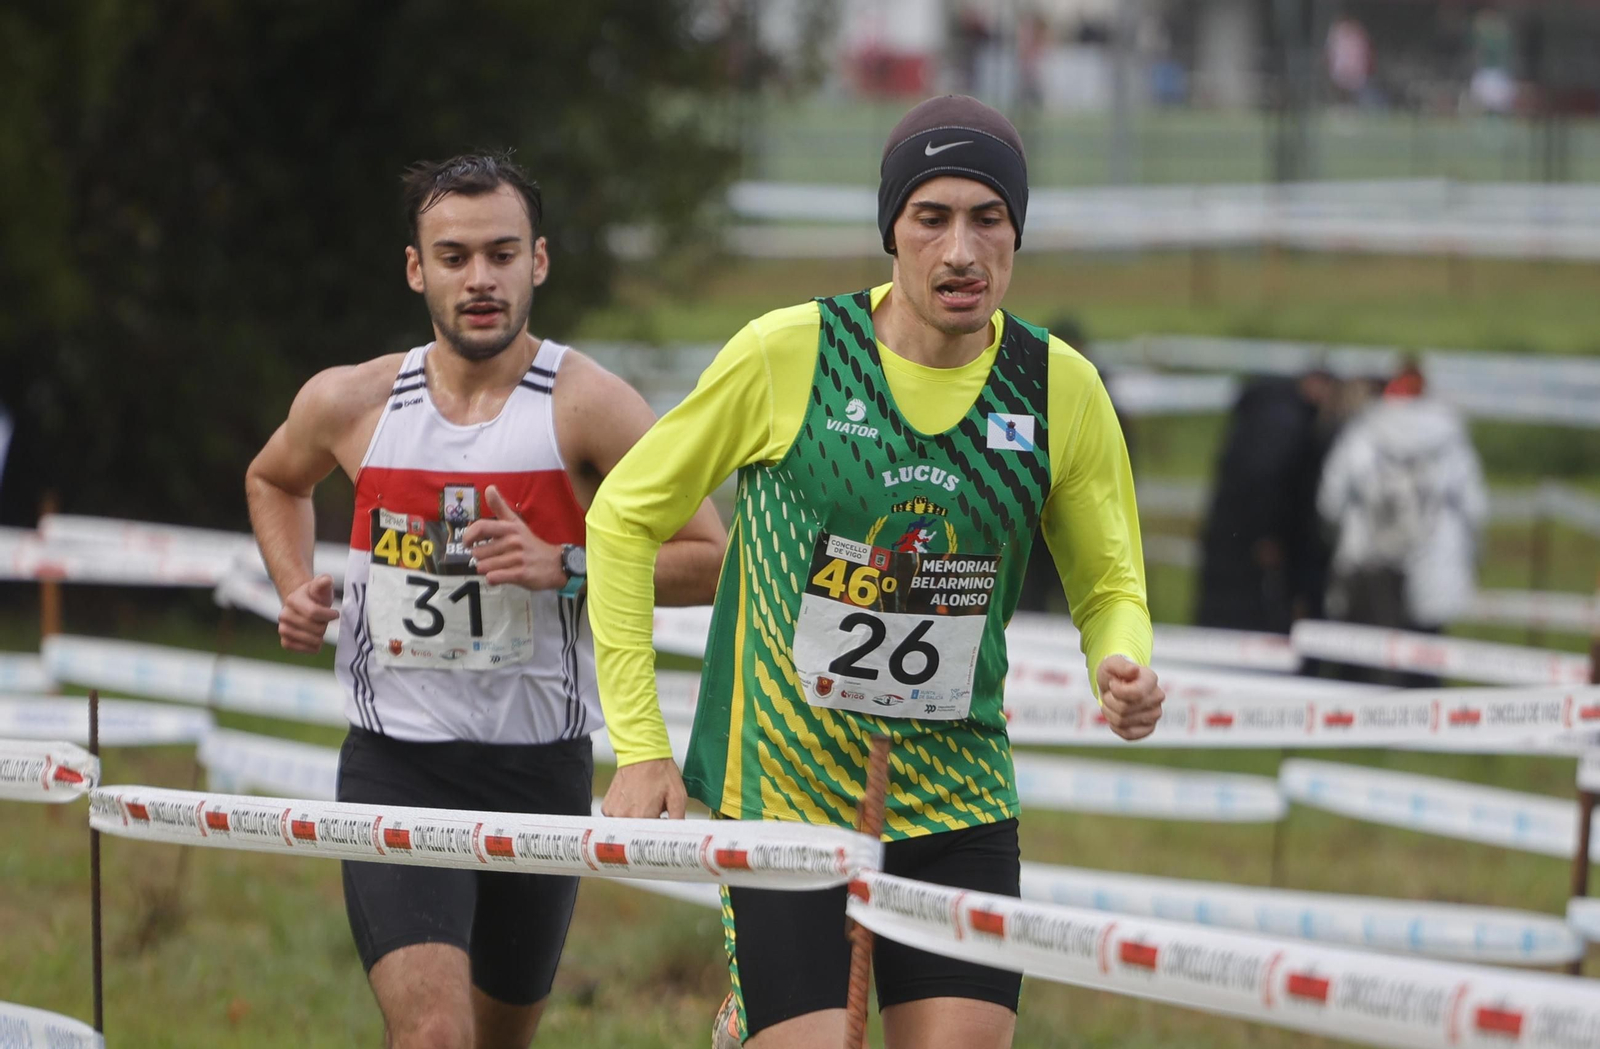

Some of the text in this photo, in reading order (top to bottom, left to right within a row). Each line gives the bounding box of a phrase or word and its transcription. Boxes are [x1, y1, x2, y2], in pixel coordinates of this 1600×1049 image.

[826, 418, 879, 440] VIATOR
[881, 465, 960, 492] LUCUS
[831, 539, 868, 554] CONCELLO
[833, 547, 863, 560] DE VIGO
[921, 559, 998, 573] MEMORIAL
[910, 577, 995, 590] BELARMINO
[402, 574, 483, 638] 31
[930, 593, 989, 606] ALONSO
[828, 611, 940, 686] 26
